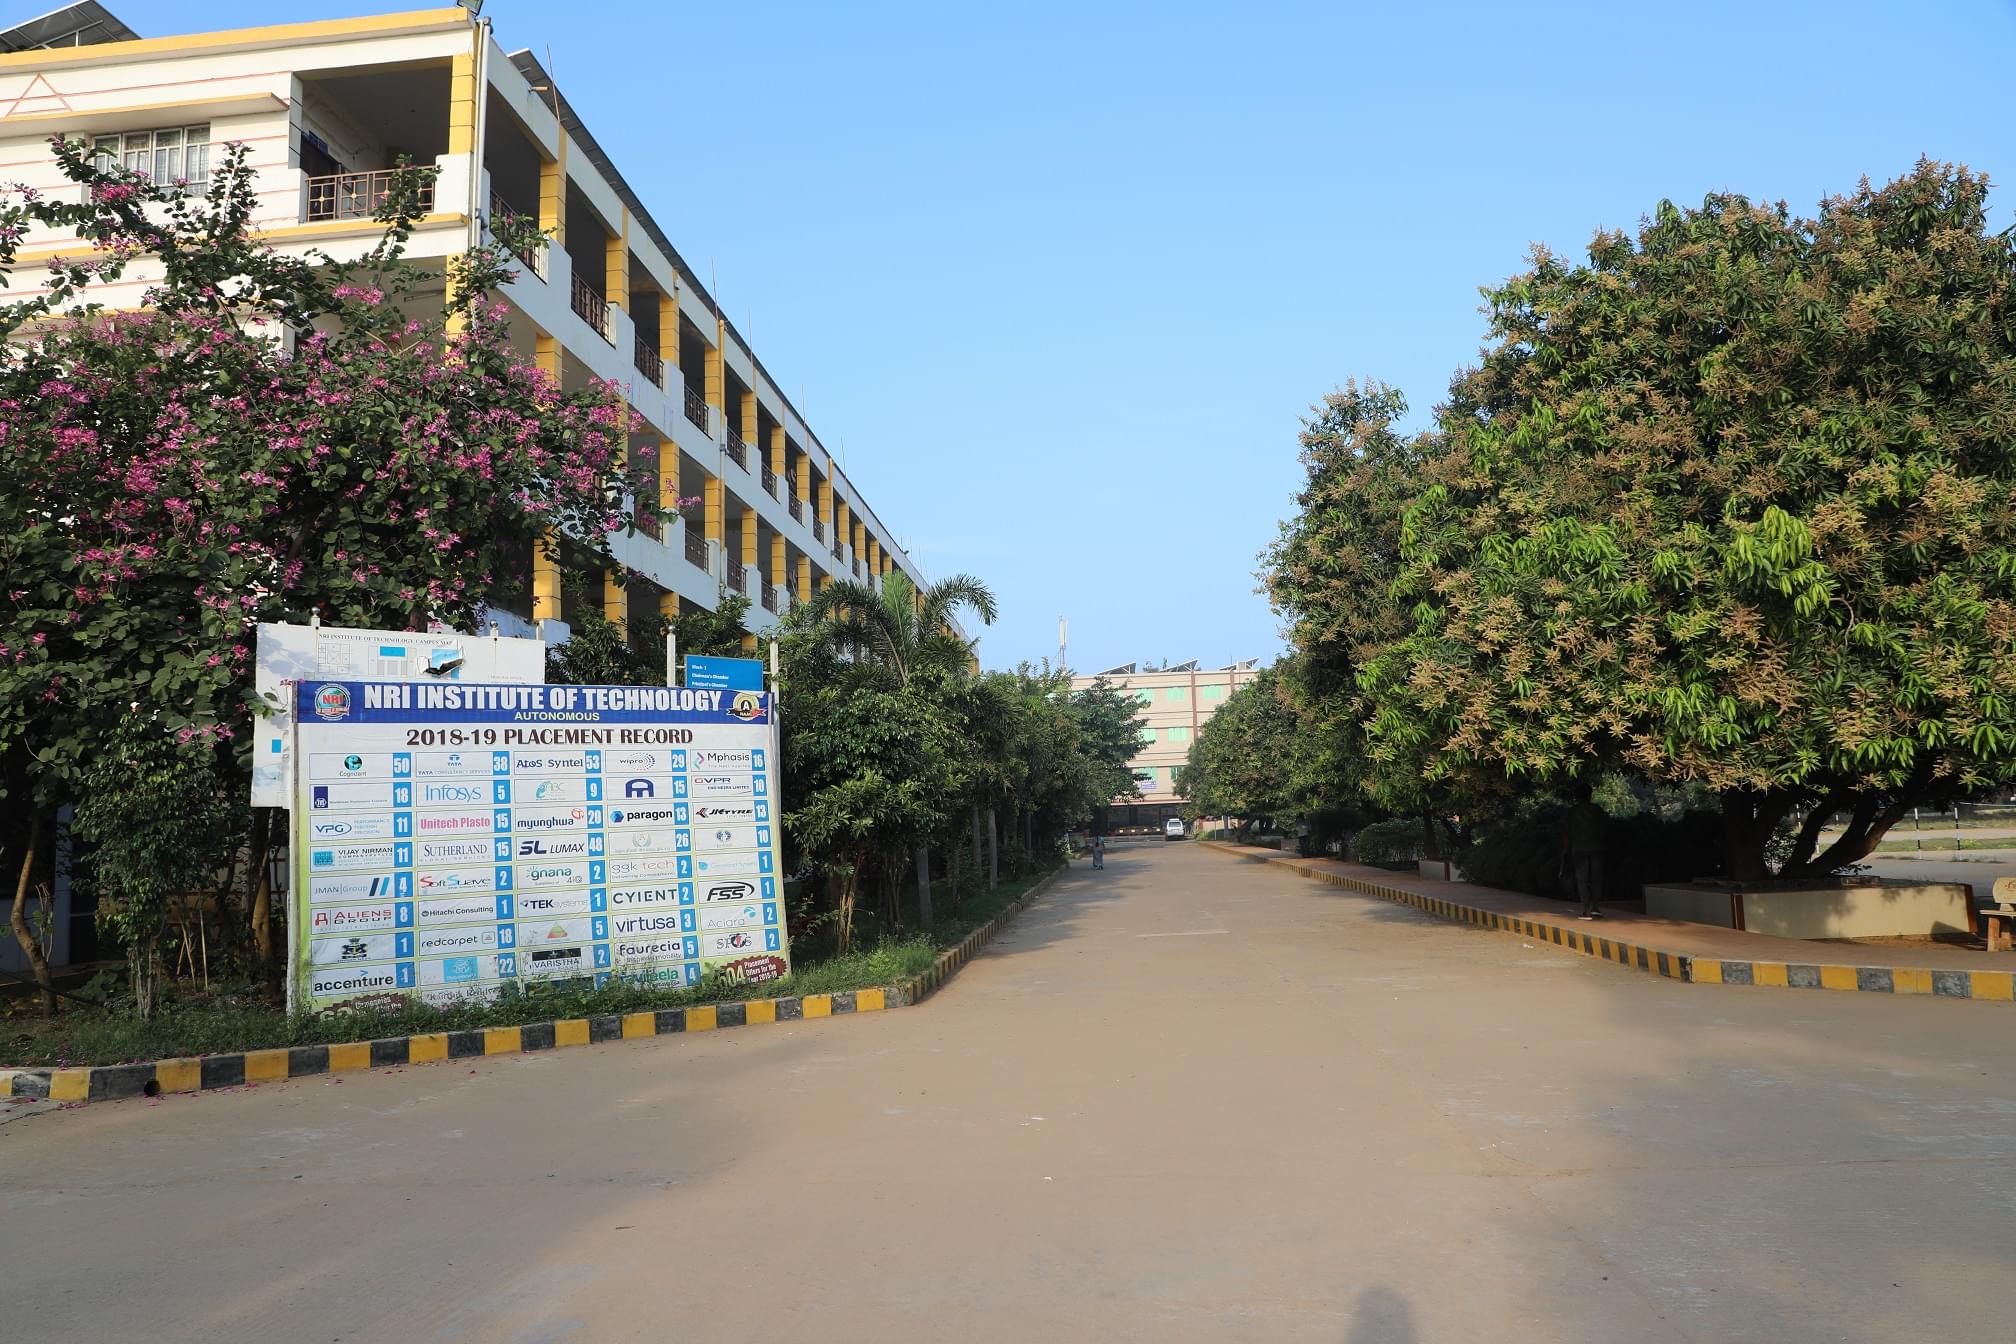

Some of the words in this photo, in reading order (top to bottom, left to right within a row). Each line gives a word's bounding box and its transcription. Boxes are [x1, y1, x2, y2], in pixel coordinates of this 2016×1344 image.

[322, 694, 344, 704] NRI
[364, 684, 411, 709] NRI
[417, 685, 545, 710] INSTITUTE
[549, 687, 578, 710] OF
[582, 687, 722, 711] TECHNOLOGY
[743, 701, 750, 711] A
[514, 711, 600, 721] AUTONOMOUS
[406, 728, 497, 746] 2018-19
[504, 728, 615, 745] PLACEMENT
[620, 728, 693, 744] RECORD
[493, 756, 508, 771] 38
[548, 759, 583, 768] Syntel
[585, 755, 600, 769] 53
[672, 754, 684, 768] 29
[707, 752, 750, 763] Mphasis
[753, 754, 762, 767] 16
[393, 758, 410, 773] 50
[497, 784, 506, 800] 5
[590, 783, 597, 797] 9
[673, 780, 685, 794] 15
[753, 779, 764, 792] 10
[394, 787, 409, 804] 18
[425, 784, 482, 803] Infosys
[588, 810, 602, 825] 20
[626, 811, 673, 821] paragon
[675, 807, 687, 821] 13
[756, 804, 767, 818] 13
[396, 817, 408, 832] 11
[420, 818, 458, 829] Unitech
[460, 817, 490, 827] Plasto
[495, 813, 509, 828] 15
[517, 816, 574, 829] myunghwa
[315, 824, 344, 833] VPG
[676, 833, 689, 847] 26
[757, 830, 769, 843] 10
[424, 844, 488, 857] SUTHERLAND
[495, 842, 509, 857] 15
[519, 840, 547, 855] SL
[550, 843, 584, 854] LUMAX
[589, 837, 603, 852] 48
[396, 847, 409, 863] 11
[762, 855, 768, 869] 1
[593, 865, 601, 880] 2
[611, 861, 639, 874] ggk
[642, 860, 675, 870] tech
[681, 860, 688, 874] 2
[399, 877, 407, 893] 4
[499, 870, 508, 886] 2
[342, 885, 368, 893] Group
[682, 886, 689, 901] 2
[707, 885, 746, 901] FSS
[764, 880, 770, 895] 1
[594, 892, 601, 907] 1
[613, 889, 678, 904] CYIENT
[429, 909, 455, 917] Hitachi
[455, 907, 494, 915] Consulting
[501, 899, 508, 914] 1
[334, 916, 392, 925] GROUP
[335, 909, 392, 919] ALIENS
[399, 906, 408, 922] 8
[684, 913, 691, 928] 3
[766, 907, 773, 921] 2
[596, 921, 603, 935] 5
[615, 916, 676, 933] virtusa
[421, 935, 479, 948] redcarpet
[499, 928, 513, 944] 18
[769, 933, 776, 947] 2
[400, 937, 408, 953] 1
[619, 940, 681, 956] faurecia
[686, 941, 695, 955] 5
[533, 958, 580, 969] VARISTHA
[598, 949, 605, 964] 2
[744, 957, 770, 969] Placement
[499, 958, 514, 973] 22
[746, 968, 760, 977] Offers
[768, 963, 777, 971] the
[401, 967, 408, 983] 1
[689, 967, 696, 981] 4
[314, 975, 394, 992] accenture
